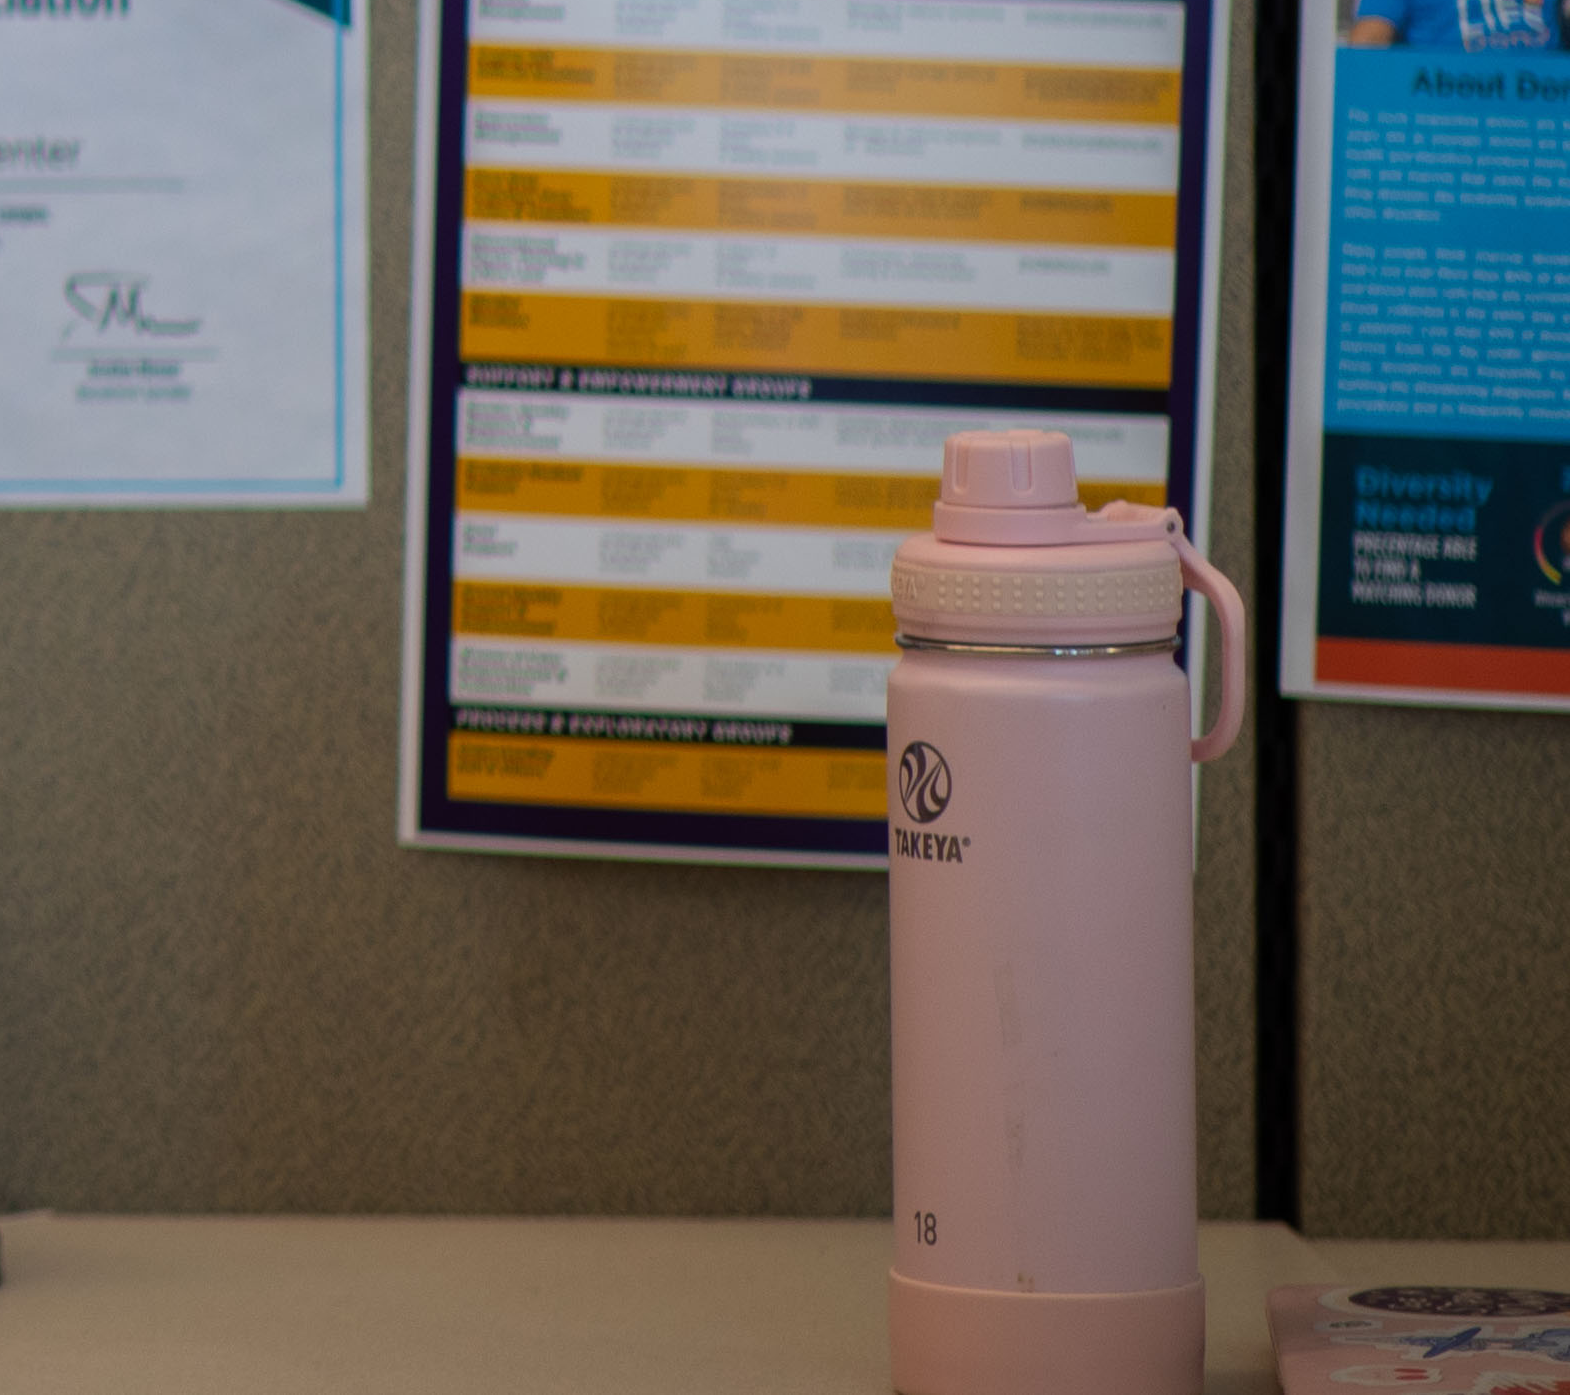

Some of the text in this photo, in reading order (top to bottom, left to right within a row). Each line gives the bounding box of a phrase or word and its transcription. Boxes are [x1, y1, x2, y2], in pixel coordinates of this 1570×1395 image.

[1414, 66, 1506, 100] About
[1354, 464, 1494, 507] Diversity
[1354, 501, 1477, 532] Needed
[1351, 579, 1477, 609] MATCHING DONOR
[914, 1211, 937, 1245] 18
